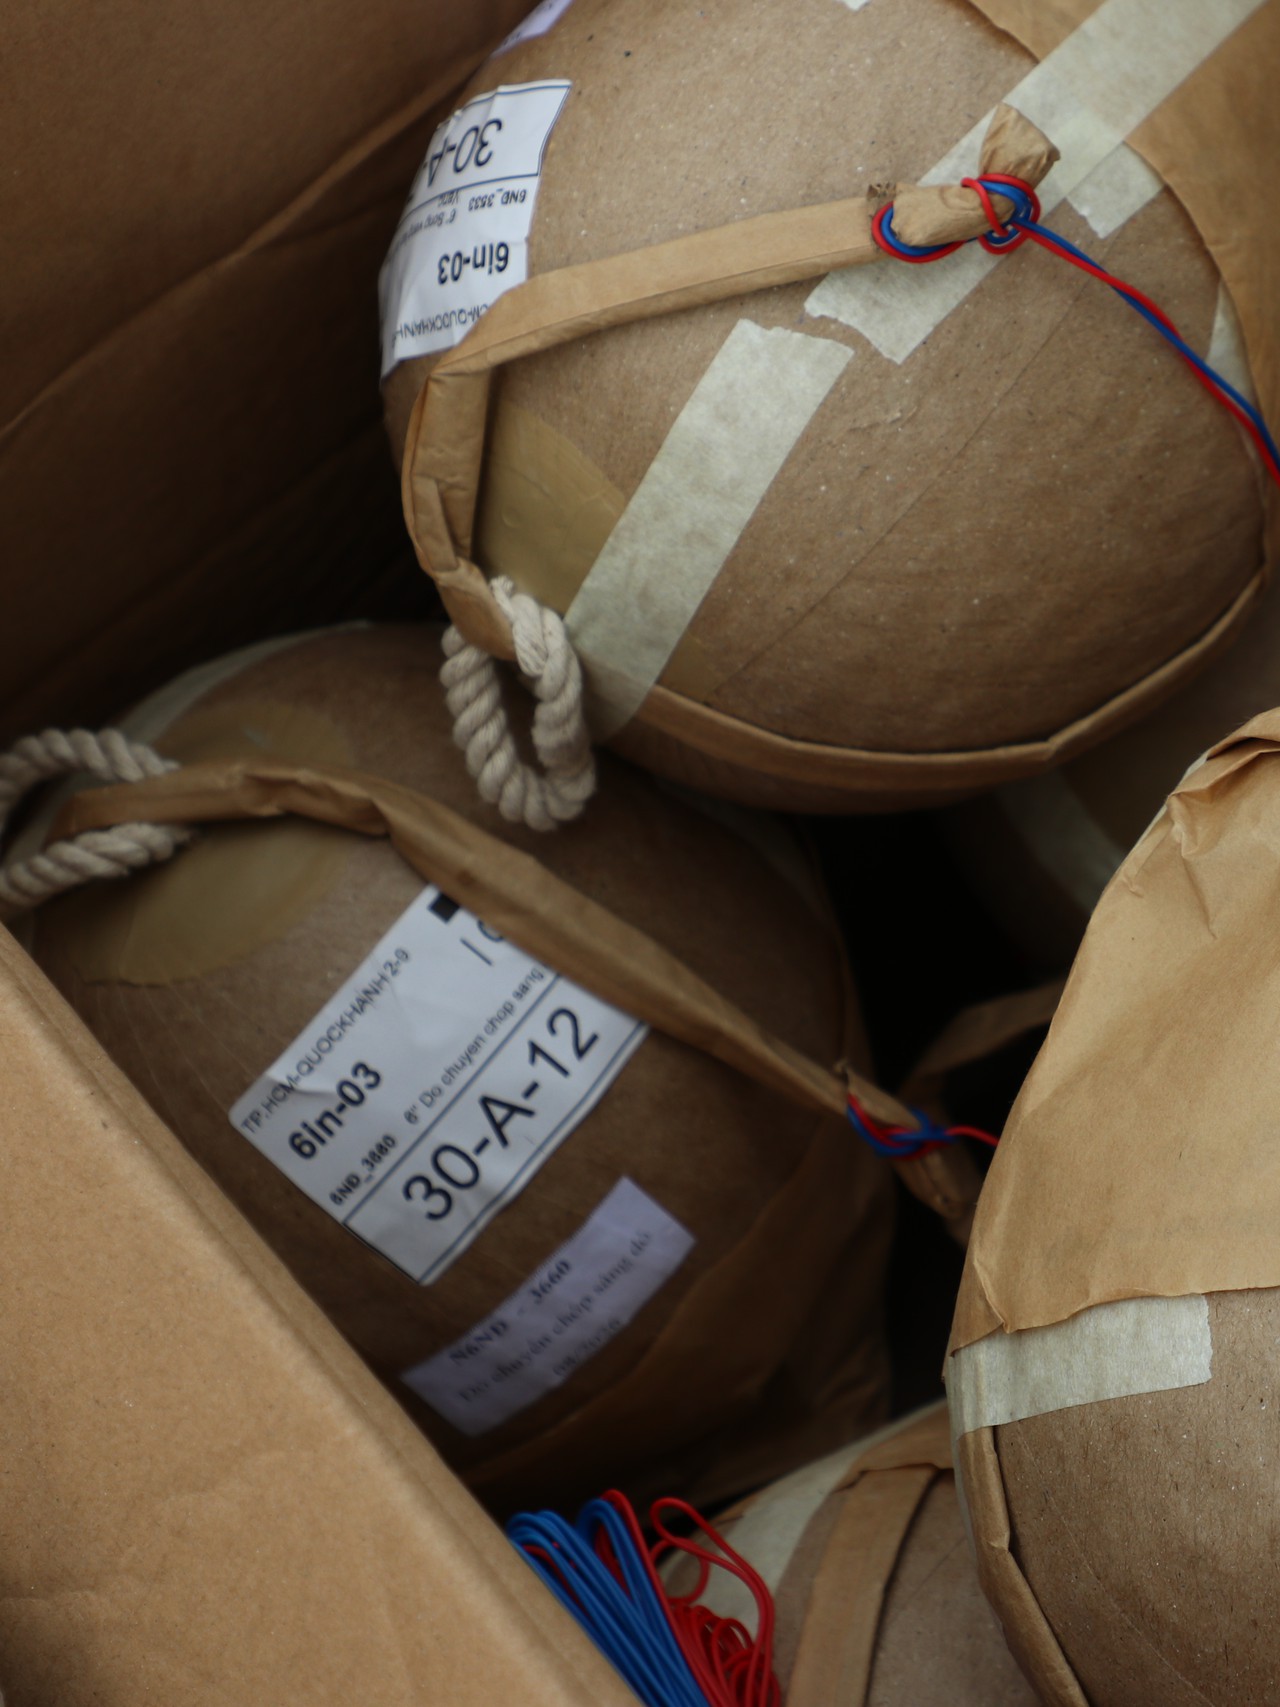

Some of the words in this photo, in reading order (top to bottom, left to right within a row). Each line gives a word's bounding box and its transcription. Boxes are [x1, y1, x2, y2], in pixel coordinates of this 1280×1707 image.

[437, 241, 509, 285] 6in-03
[241, 972, 390, 1134] TP.HCM-QUOCKHANH
[383, 947, 411, 978] 2-9
[288, 1061, 382, 1160] 6in-03
[403, 1007, 599, 1221] 30-A-12
